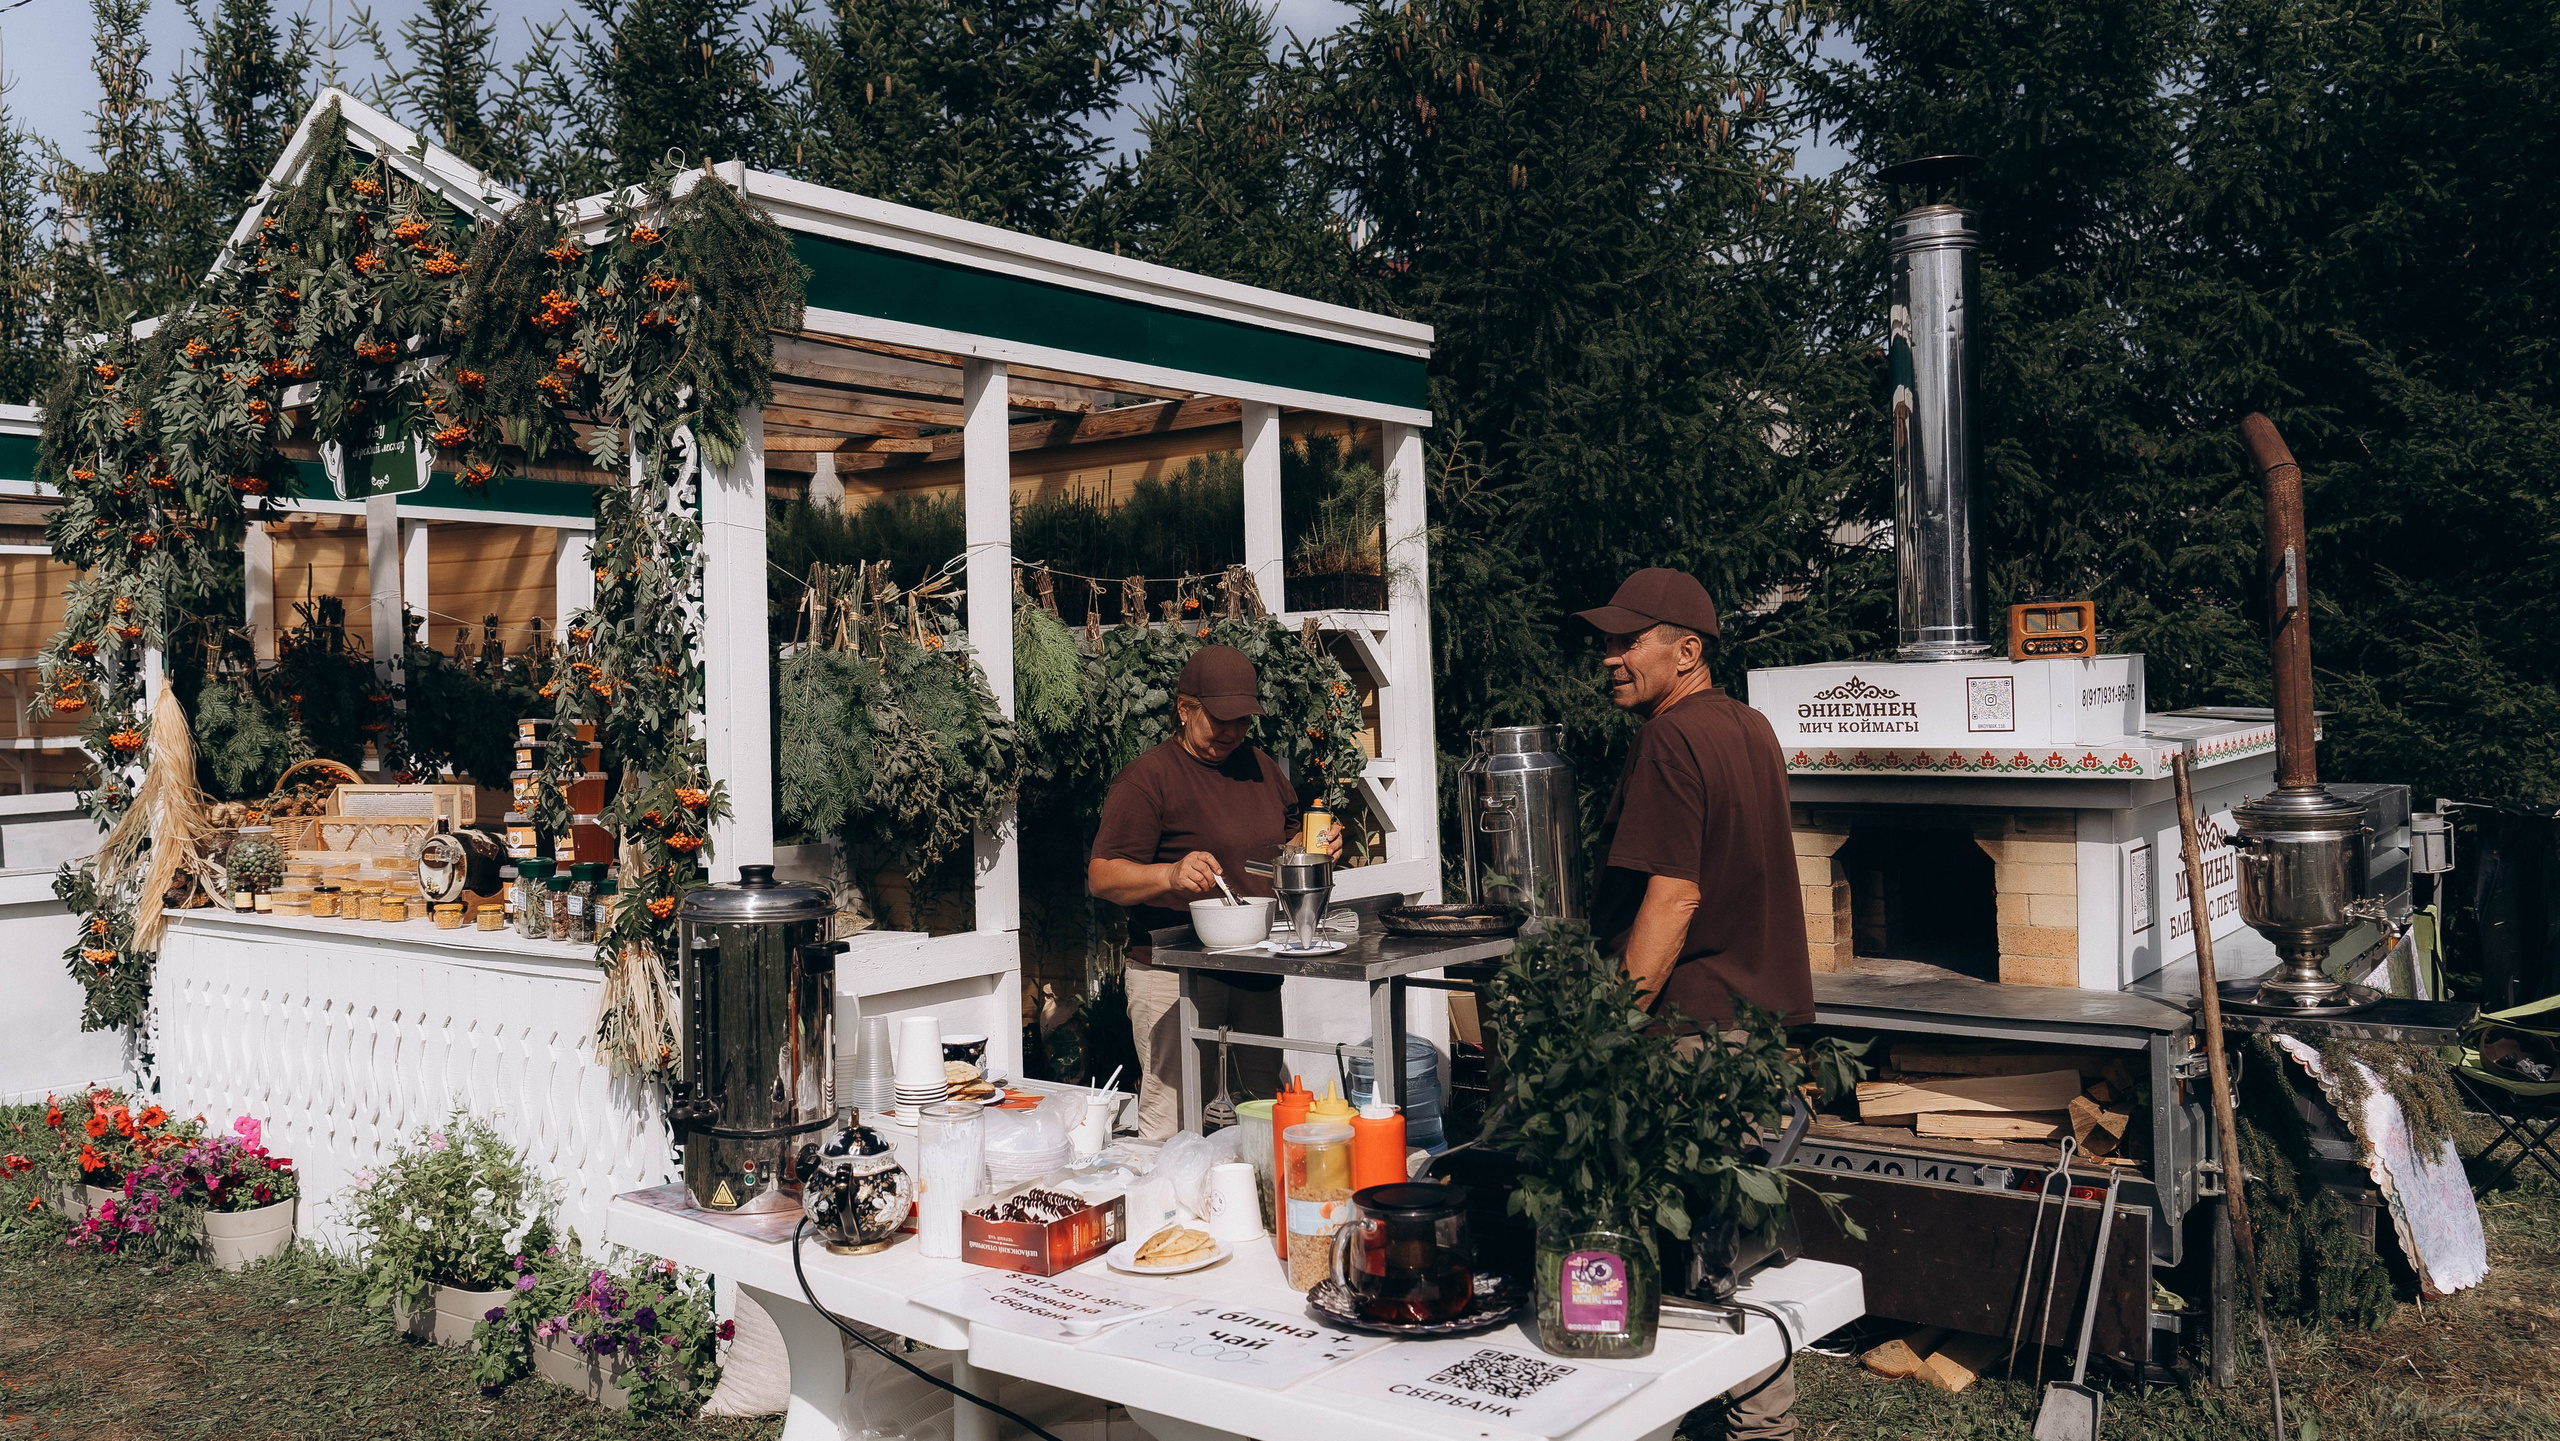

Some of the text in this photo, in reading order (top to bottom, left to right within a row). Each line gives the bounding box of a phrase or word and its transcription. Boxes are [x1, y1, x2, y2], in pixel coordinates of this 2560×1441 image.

[1798, 702, 1918, 718] ӘНИЕМНЕҢ
[2082, 684, 2135, 711] 8(917)931-96-76
[1799, 719, 1919, 733] МИЧ КОЙМАГЫ
[2175, 852, 2234, 902] МИНЫ
[2208, 900, 2215, 922] С
[990, 1294, 1075, 1321] Сбербанк
[1002, 1286, 1102, 1315] перевод на
[1217, 1311, 1320, 1339] блина
[1209, 1330, 1275, 1350] чай
[1388, 1384, 1523, 1418] СБЕРБАНК
